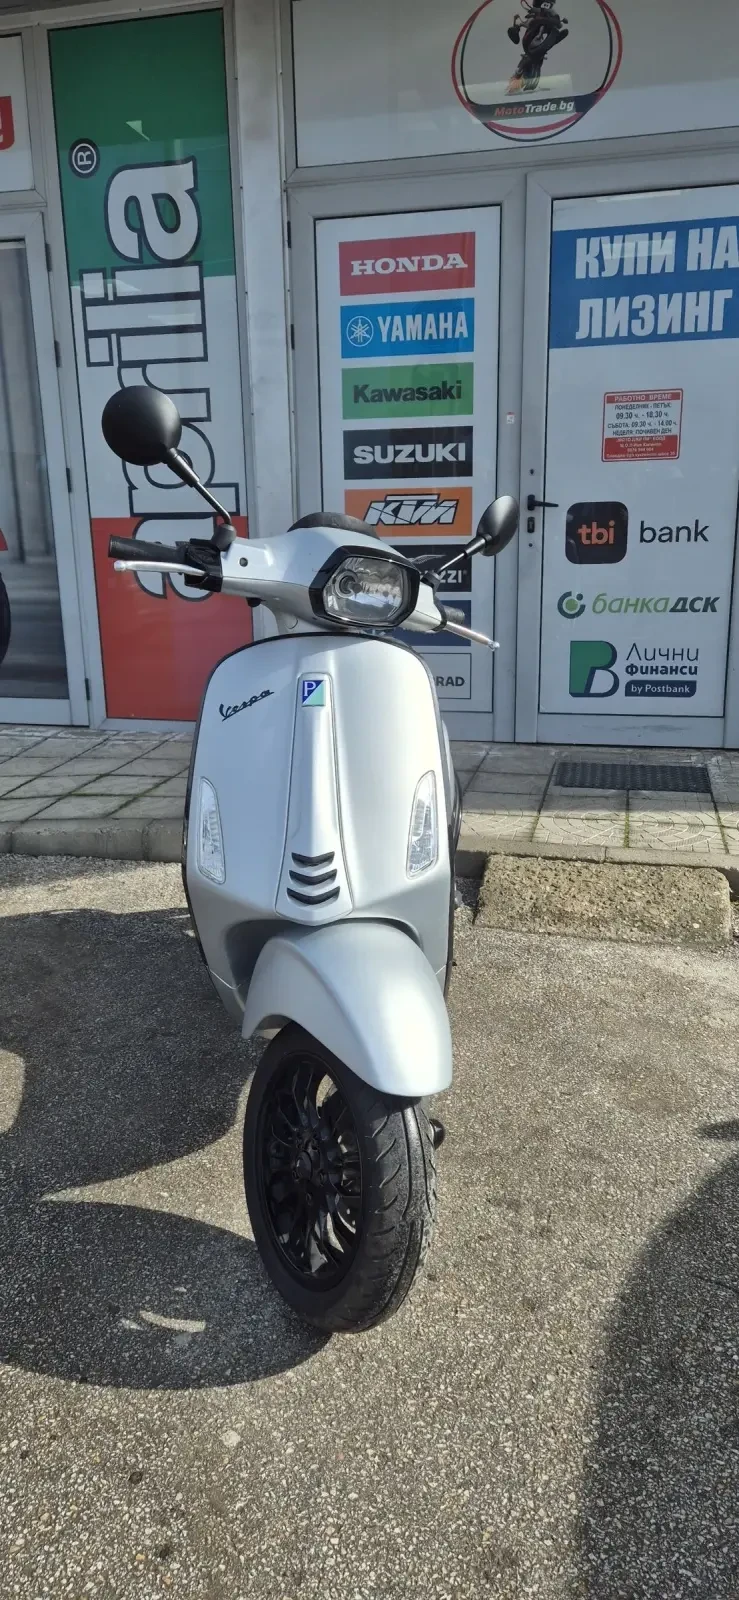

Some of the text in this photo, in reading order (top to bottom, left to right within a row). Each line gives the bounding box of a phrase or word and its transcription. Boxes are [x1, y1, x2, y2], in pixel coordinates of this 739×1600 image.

[350, 253, 468, 276] HONDA
[575, 225, 739, 280] КУПИ НА
[377, 311, 469, 343] YAMAHA
[575, 289, 734, 340] ЛИЗИНГ
[353, 380, 462, 404] Kawasaki
[614, 394, 646, 402] РАБОТНО
[353, 442, 466, 465] SUZUKI
[363, 492, 460, 526] KTM
[577, 519, 710, 546] tbi bank
[625, 641, 700, 662] Лични
[631, 684, 690, 694] by Postbank
[218, 689, 275, 721] Vespa
